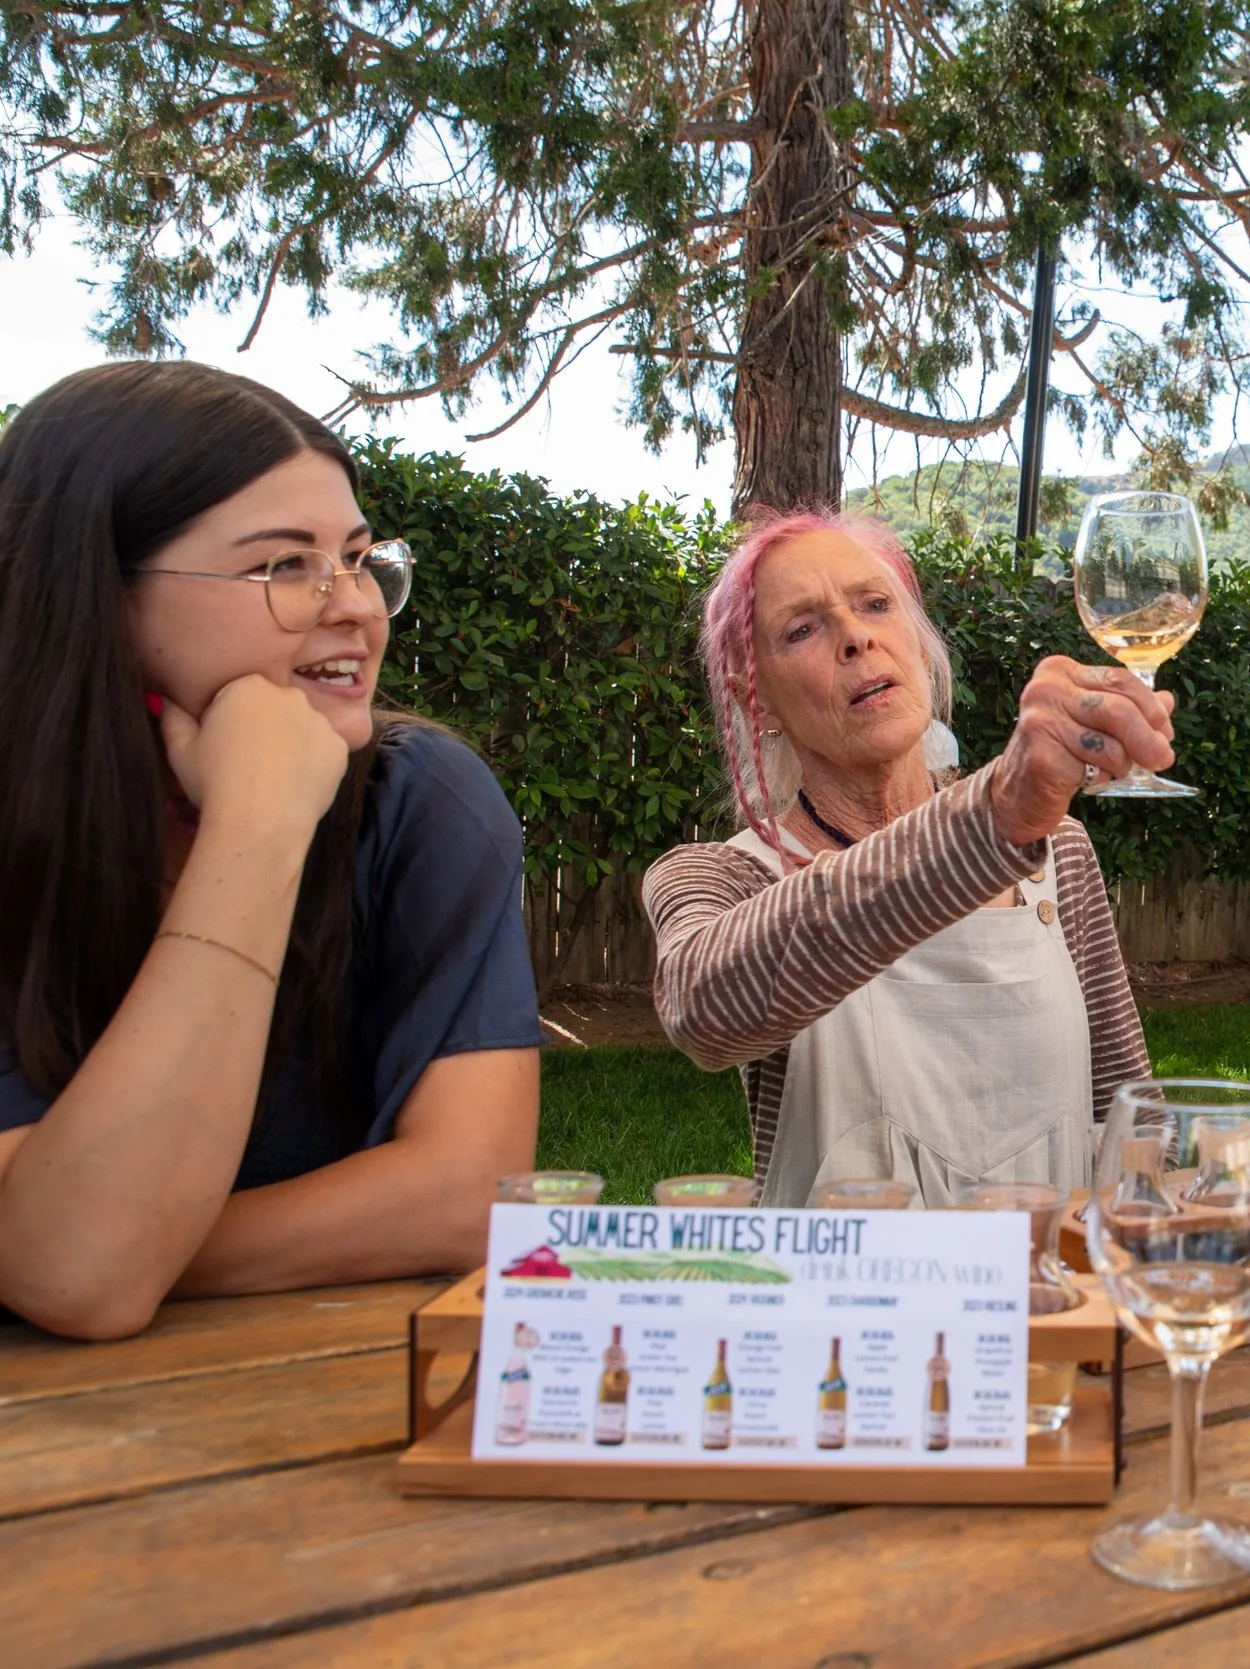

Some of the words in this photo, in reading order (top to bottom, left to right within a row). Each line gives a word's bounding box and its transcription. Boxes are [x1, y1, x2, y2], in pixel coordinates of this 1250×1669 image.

[547, 1209, 660, 1249] SUMMER
[669, 1213, 766, 1252] WHITES
[774, 1216, 867, 1256] FLIGHT
[856, 1256, 947, 1285] OREGON
